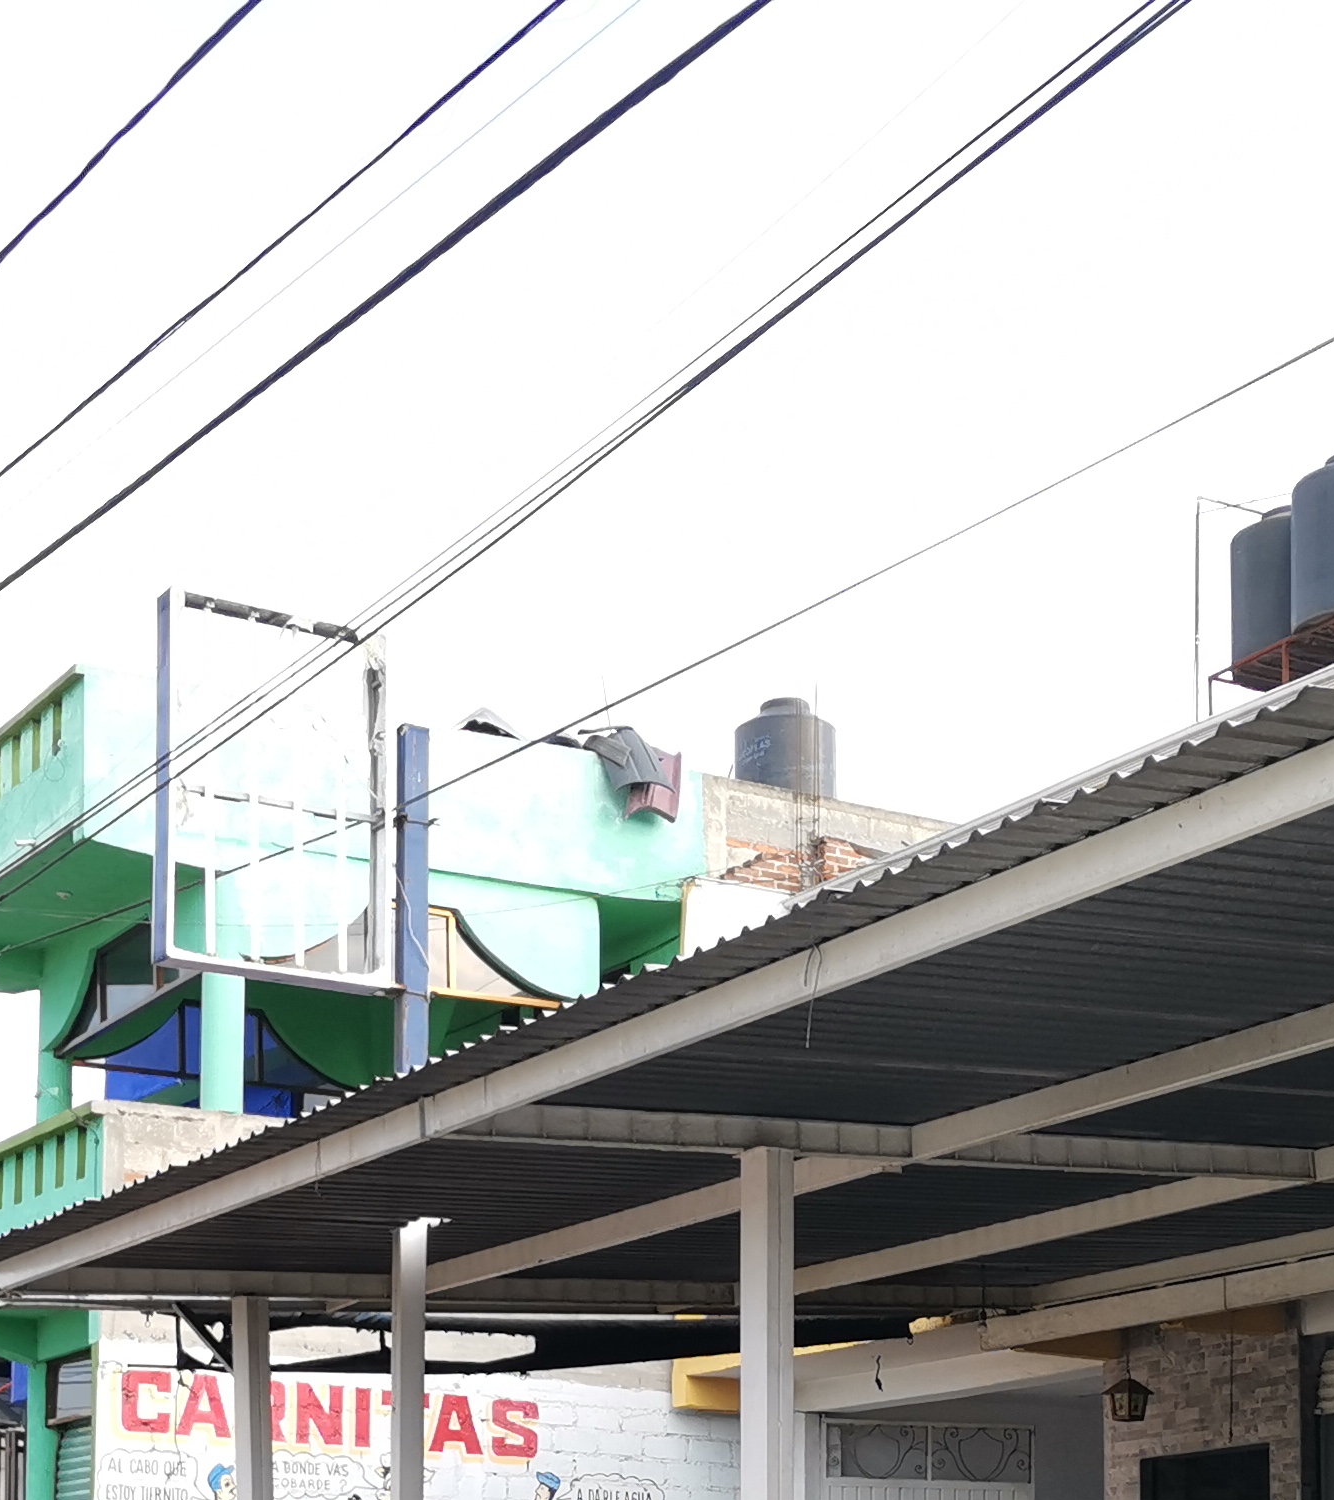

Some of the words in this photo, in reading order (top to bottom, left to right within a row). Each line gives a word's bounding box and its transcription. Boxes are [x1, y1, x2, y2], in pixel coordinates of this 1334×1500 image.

[121, 1370, 540, 1458] CANIAS
[107, 1457, 122, 1473] AL
[129, 1458, 159, 1475] CABO
[163, 1459, 187, 1479] QUE
[326, 1463, 349, 1477] VAS
[105, 1483, 135, 1500] ESTOY
